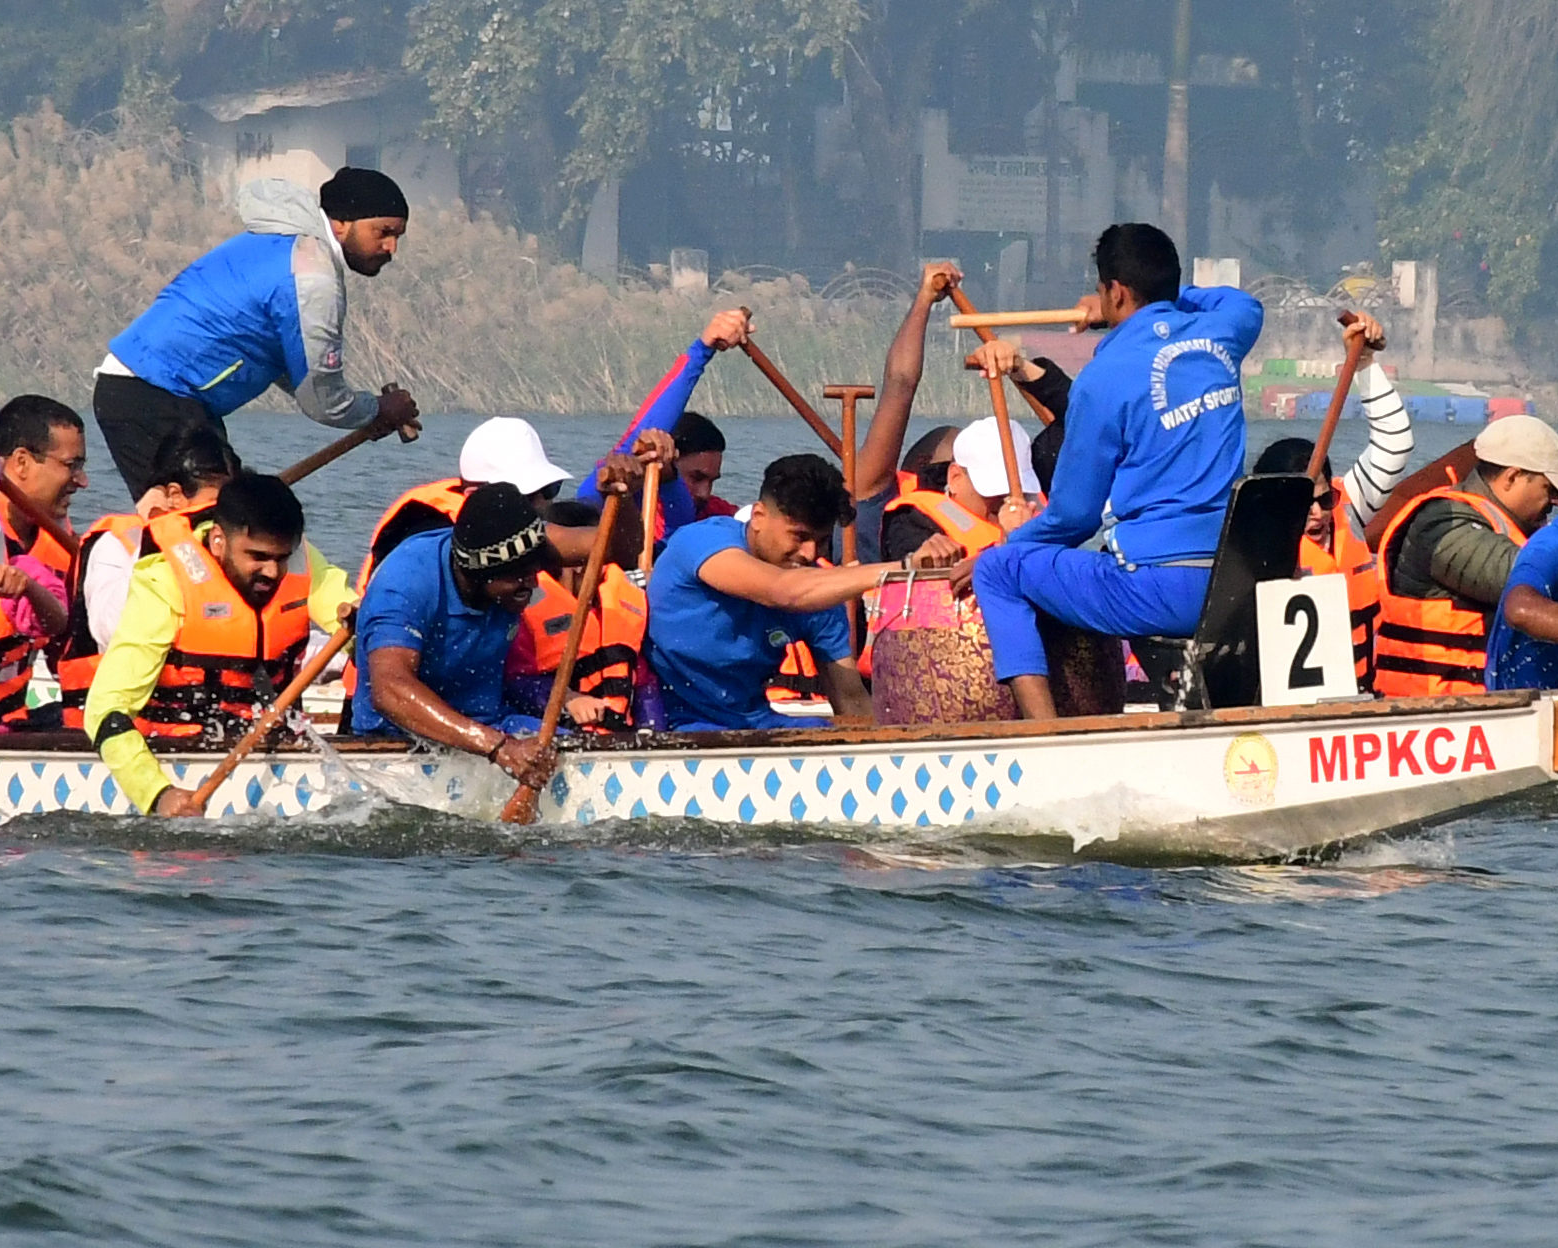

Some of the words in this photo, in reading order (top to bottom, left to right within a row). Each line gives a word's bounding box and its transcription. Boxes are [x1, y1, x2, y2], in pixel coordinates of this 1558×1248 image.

[1160, 397, 1204, 430] WATER
[1203, 386, 1241, 410] SPORTS
[1284, 593, 1325, 690] 2
[1309, 725, 1497, 784] MPKCA
